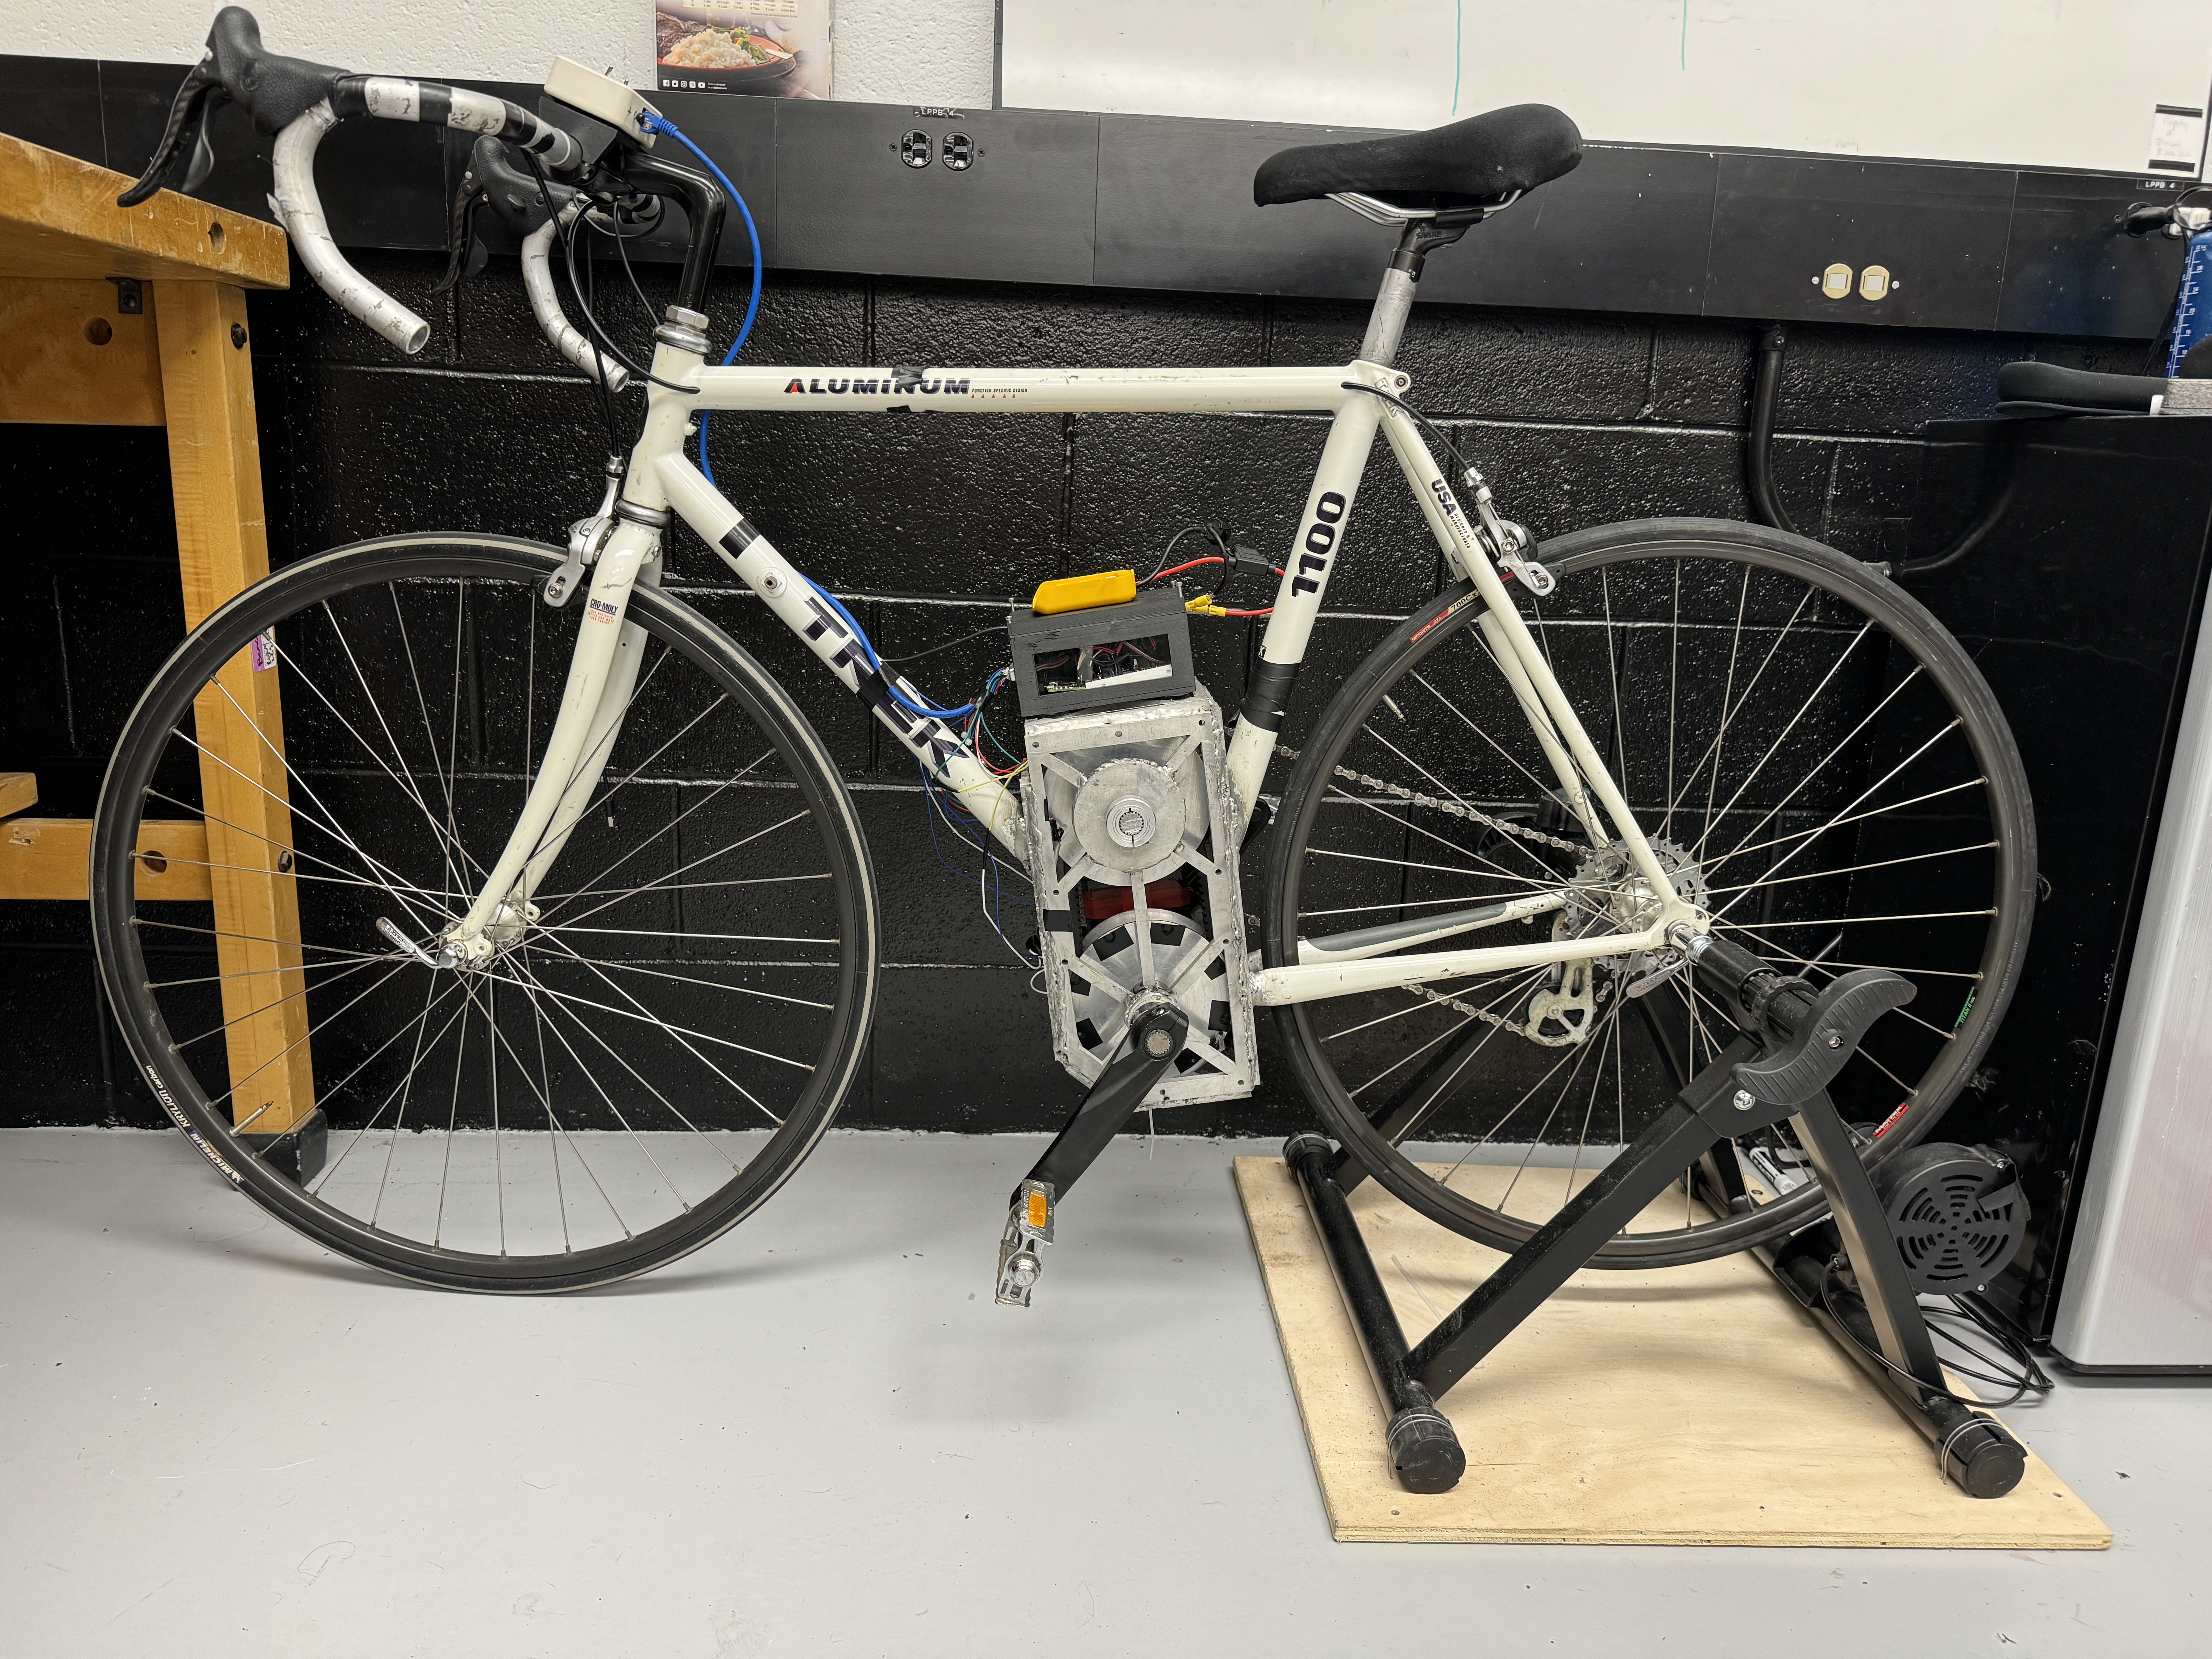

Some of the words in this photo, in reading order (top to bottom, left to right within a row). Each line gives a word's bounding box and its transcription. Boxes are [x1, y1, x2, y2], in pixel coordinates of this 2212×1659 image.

[783, 378, 970, 395] ALUMINUM
[1431, 479, 1457, 517] USA
[1450, 515, 1470, 548] MANUFACTURED
[1454, 513, 1468, 535] DESIGNED
[1292, 491, 1346, 598] 1100
[802, 596, 970, 778] TREK
[1959, 1006, 1970, 1024] TITAN
[146, 1065, 164, 1089] carbon
[1875, 1104, 1903, 1134] MATRIX
[190, 1133, 232, 1176] MICHELIN
